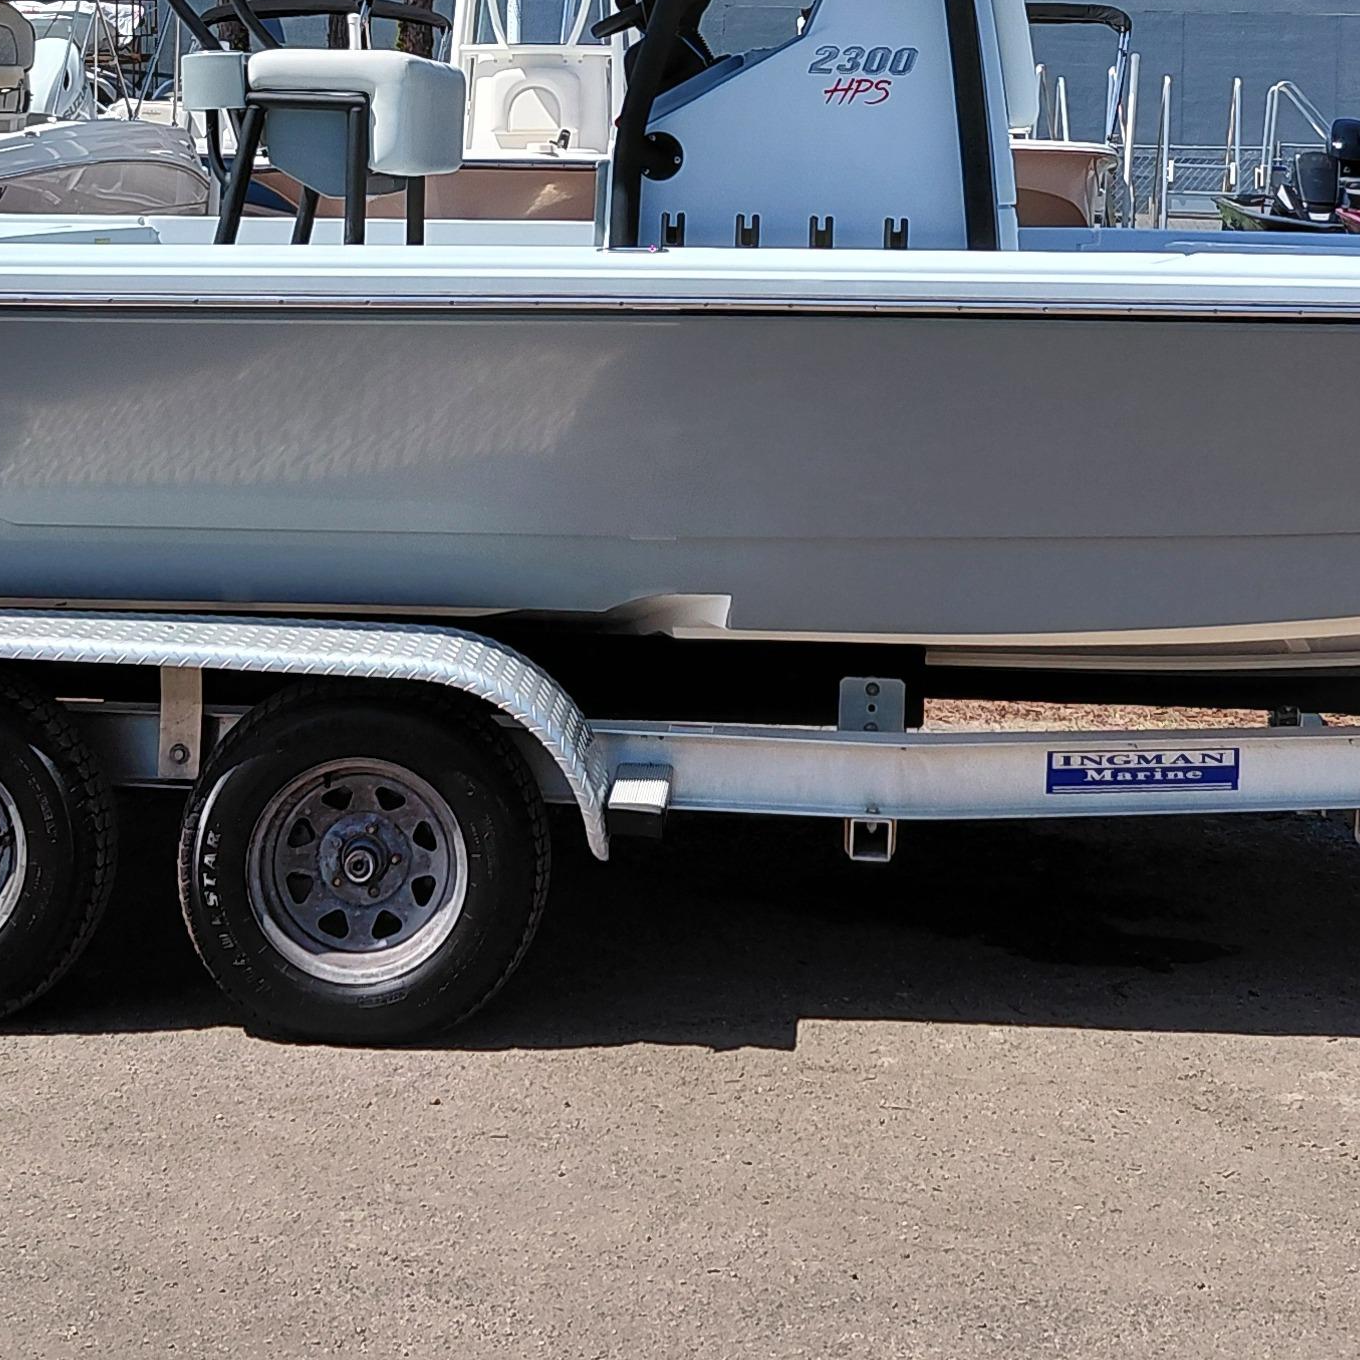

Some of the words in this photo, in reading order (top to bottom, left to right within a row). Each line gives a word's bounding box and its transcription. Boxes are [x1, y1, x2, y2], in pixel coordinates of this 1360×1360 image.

[808, 45, 919, 76] 2300
[824, 78, 892, 105] HPS
[1060, 752, 1226, 767] INGMAN
[1083, 768, 1203, 782] Marine
